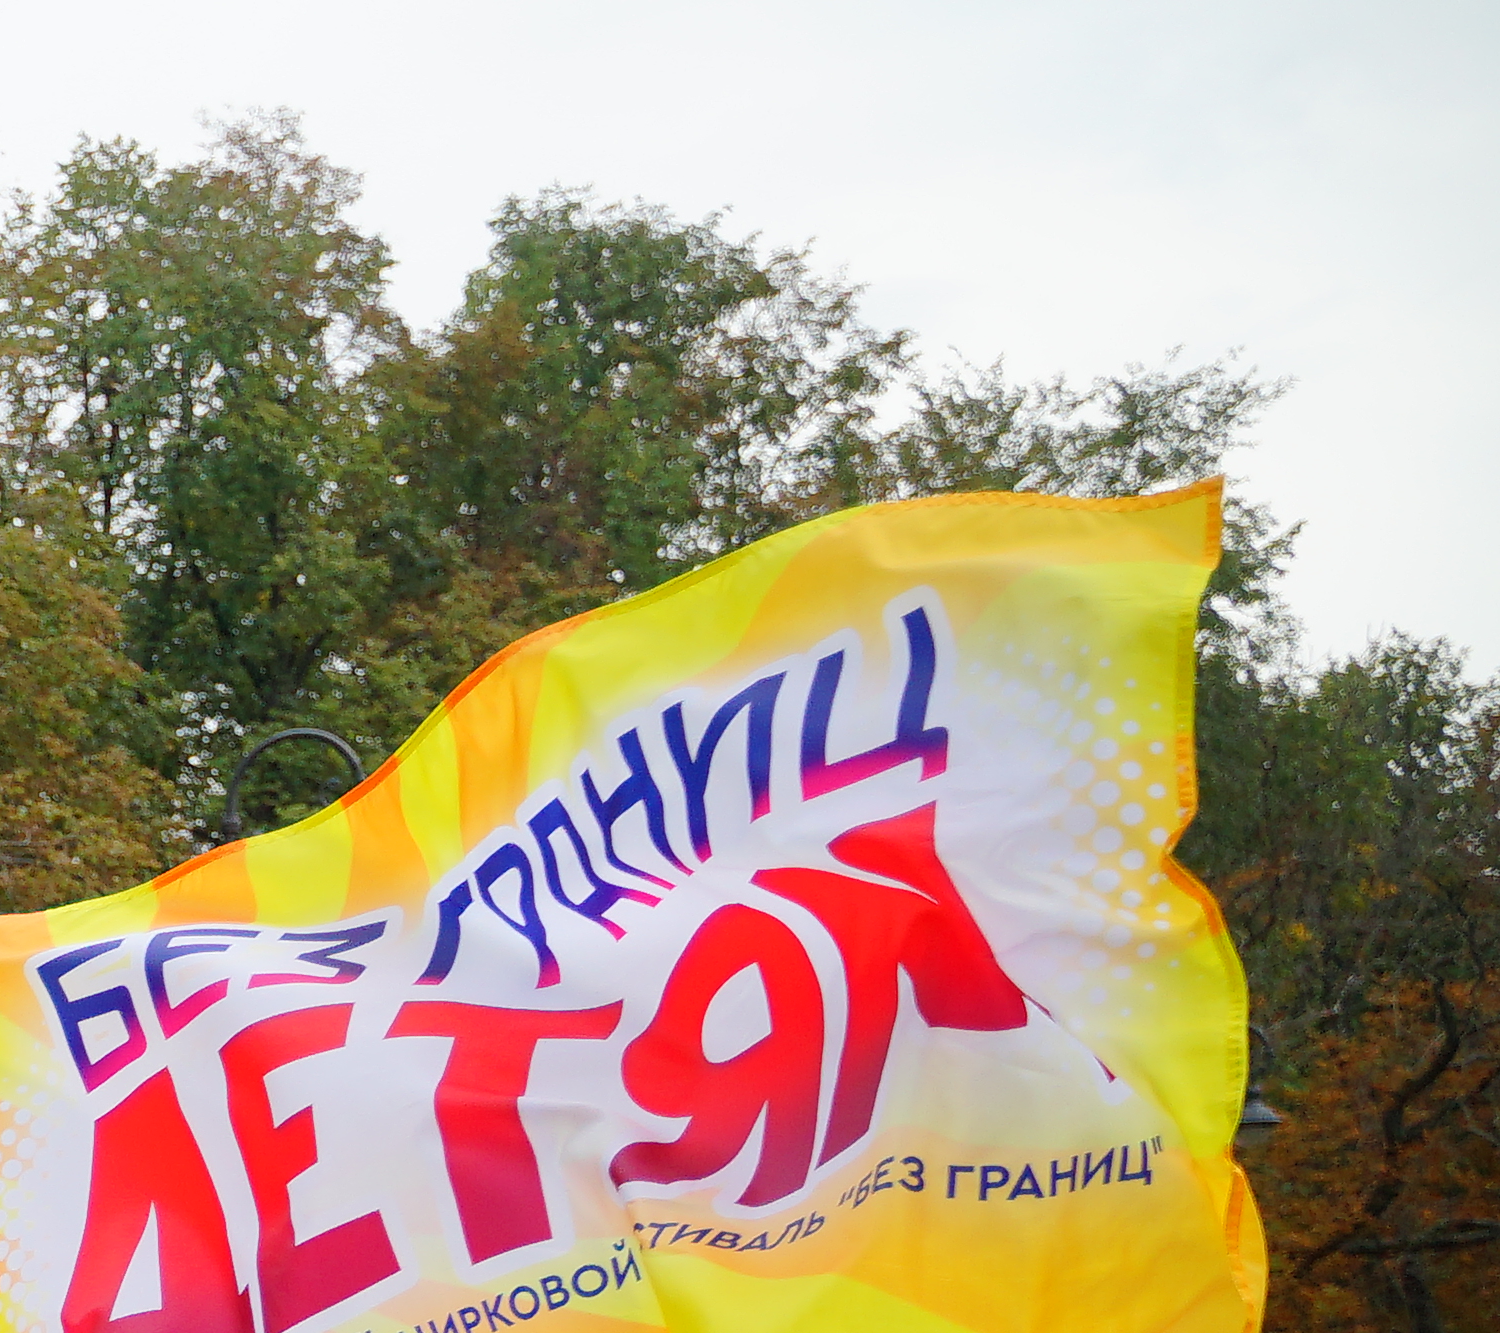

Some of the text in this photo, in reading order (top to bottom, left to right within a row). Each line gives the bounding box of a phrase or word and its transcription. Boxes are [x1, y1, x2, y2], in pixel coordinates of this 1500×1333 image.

[38, 606, 950, 1092] БЕЗ ГРАНИЦ
[633, 1210, 826, 1254] ТИВАЛЬ
[946, 1133, 1165, 1202] ГРАНИЦ"
